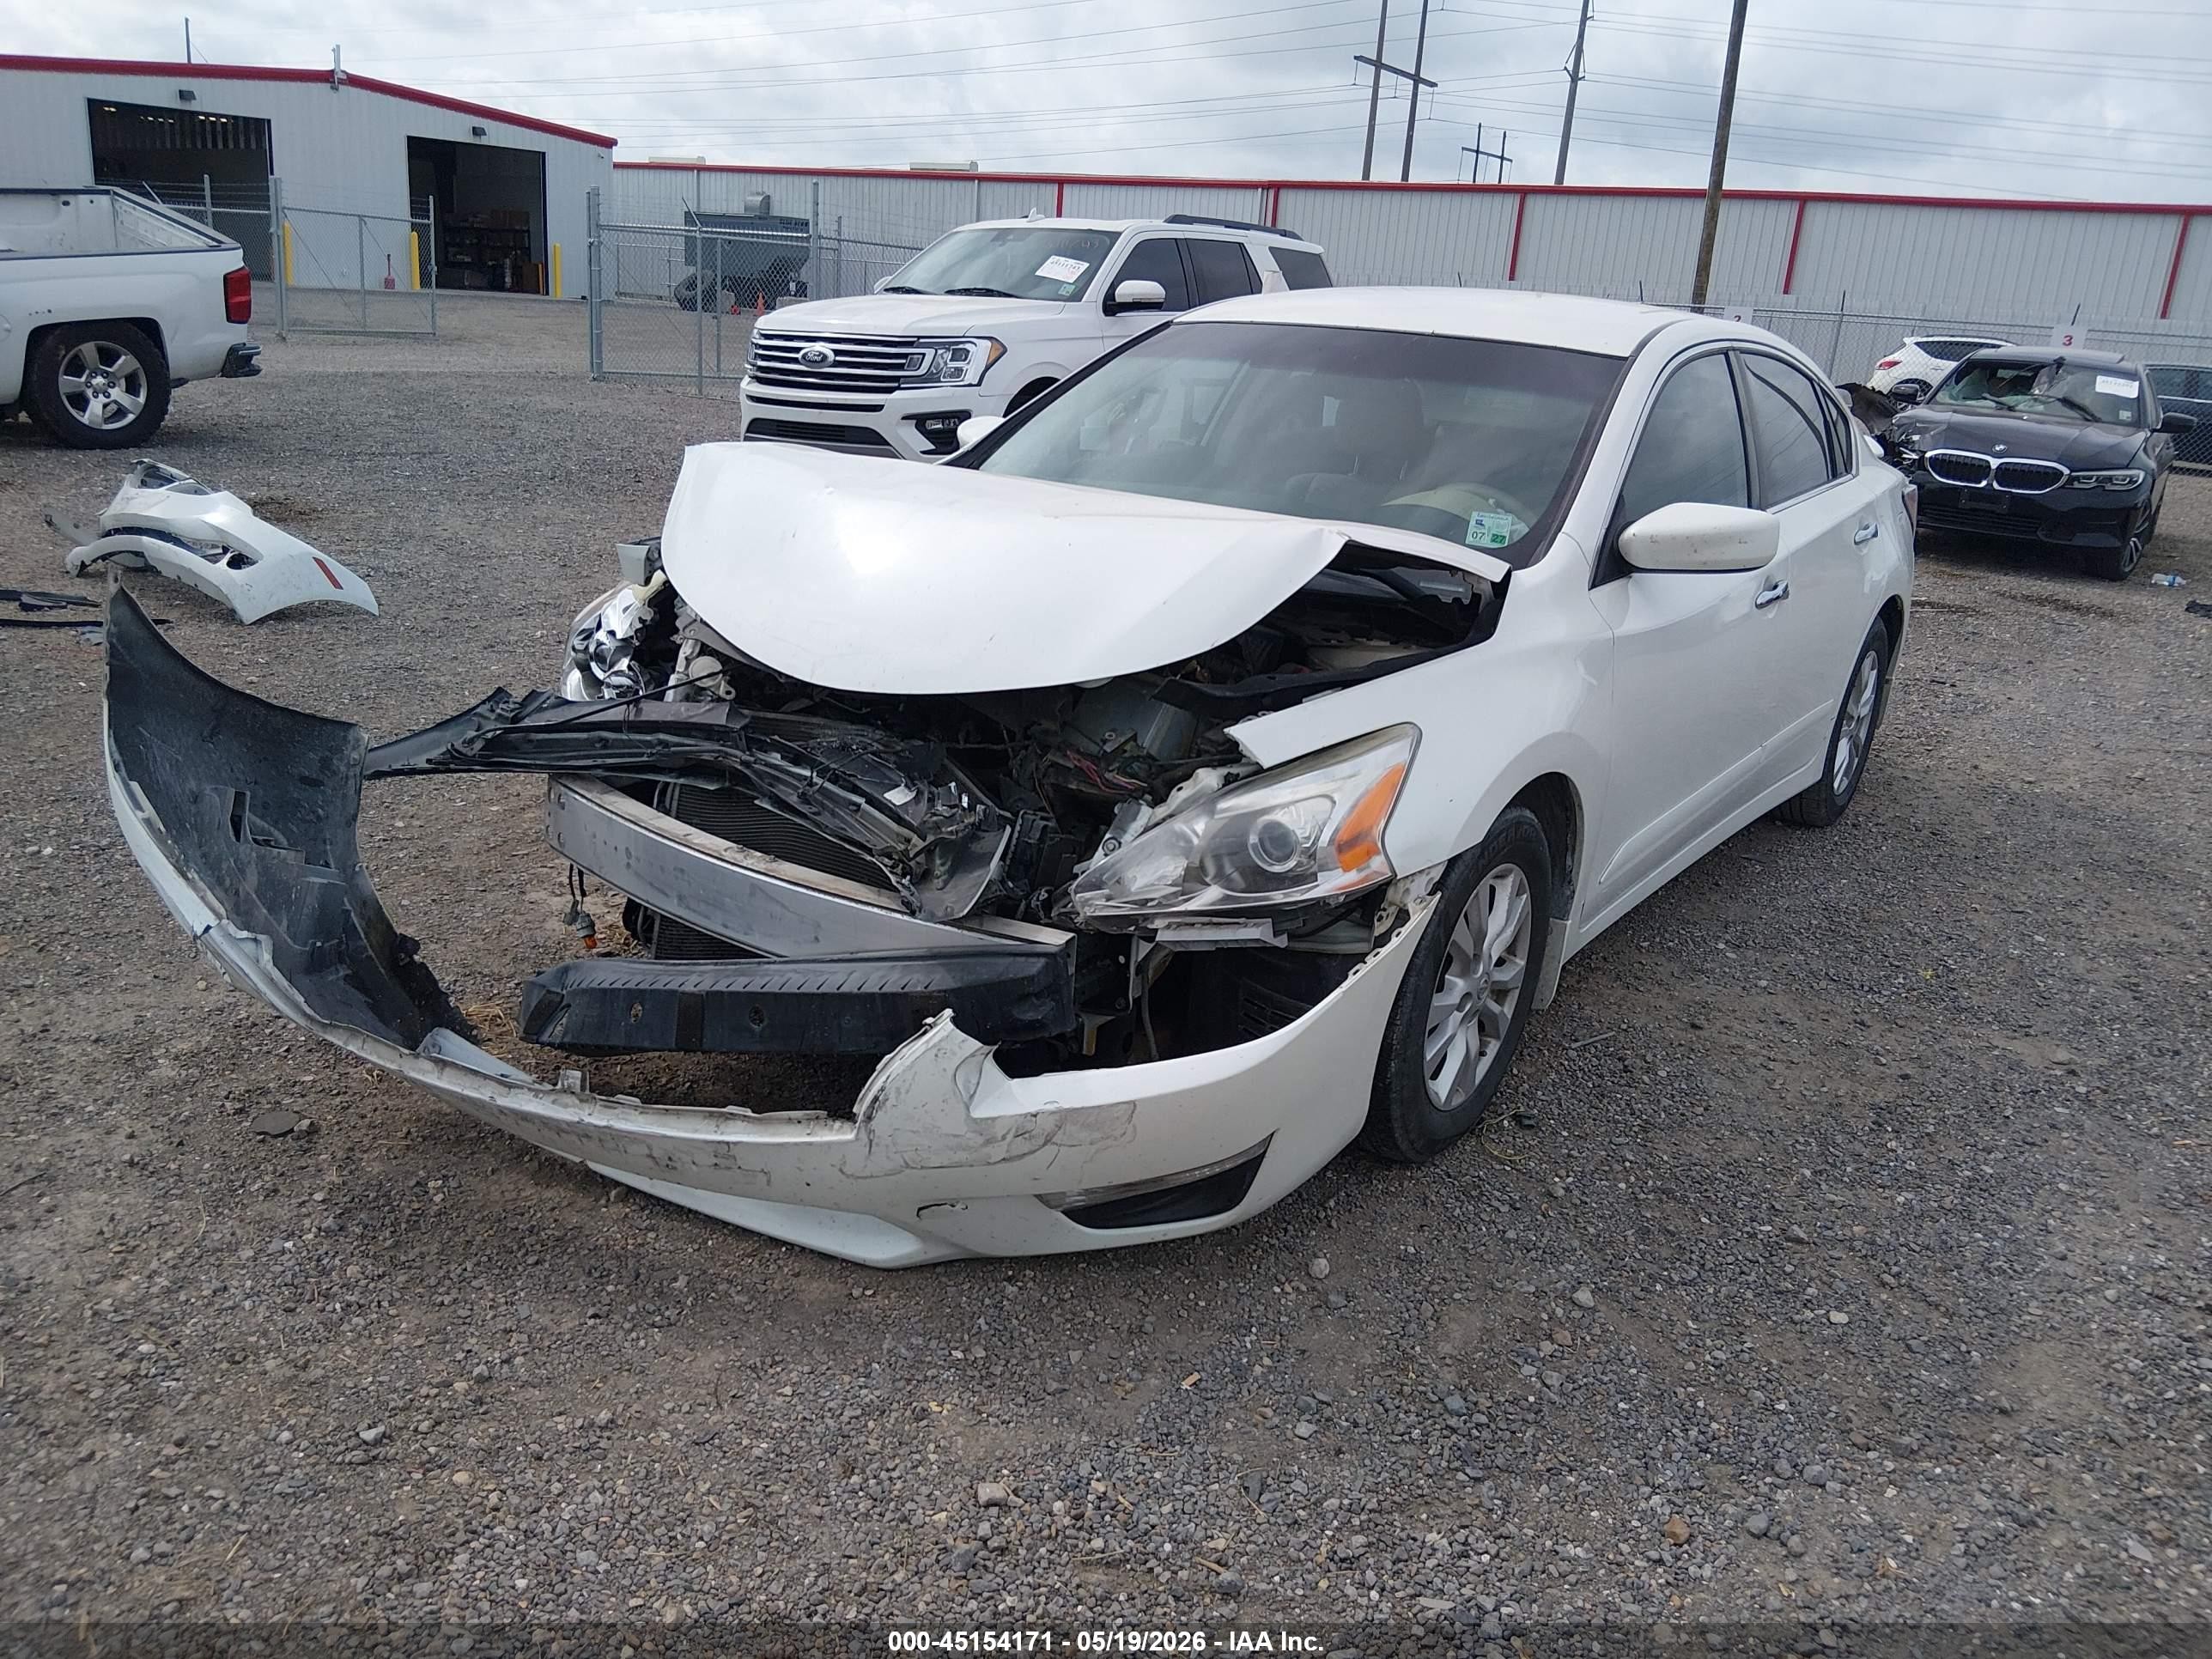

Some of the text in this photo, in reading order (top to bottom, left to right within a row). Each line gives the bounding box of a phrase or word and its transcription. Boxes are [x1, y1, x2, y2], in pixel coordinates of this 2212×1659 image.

[2062, 334, 2074, 347] 3
[805, 350, 823, 362] Ford
[1472, 531, 1506, 544] 07 27
